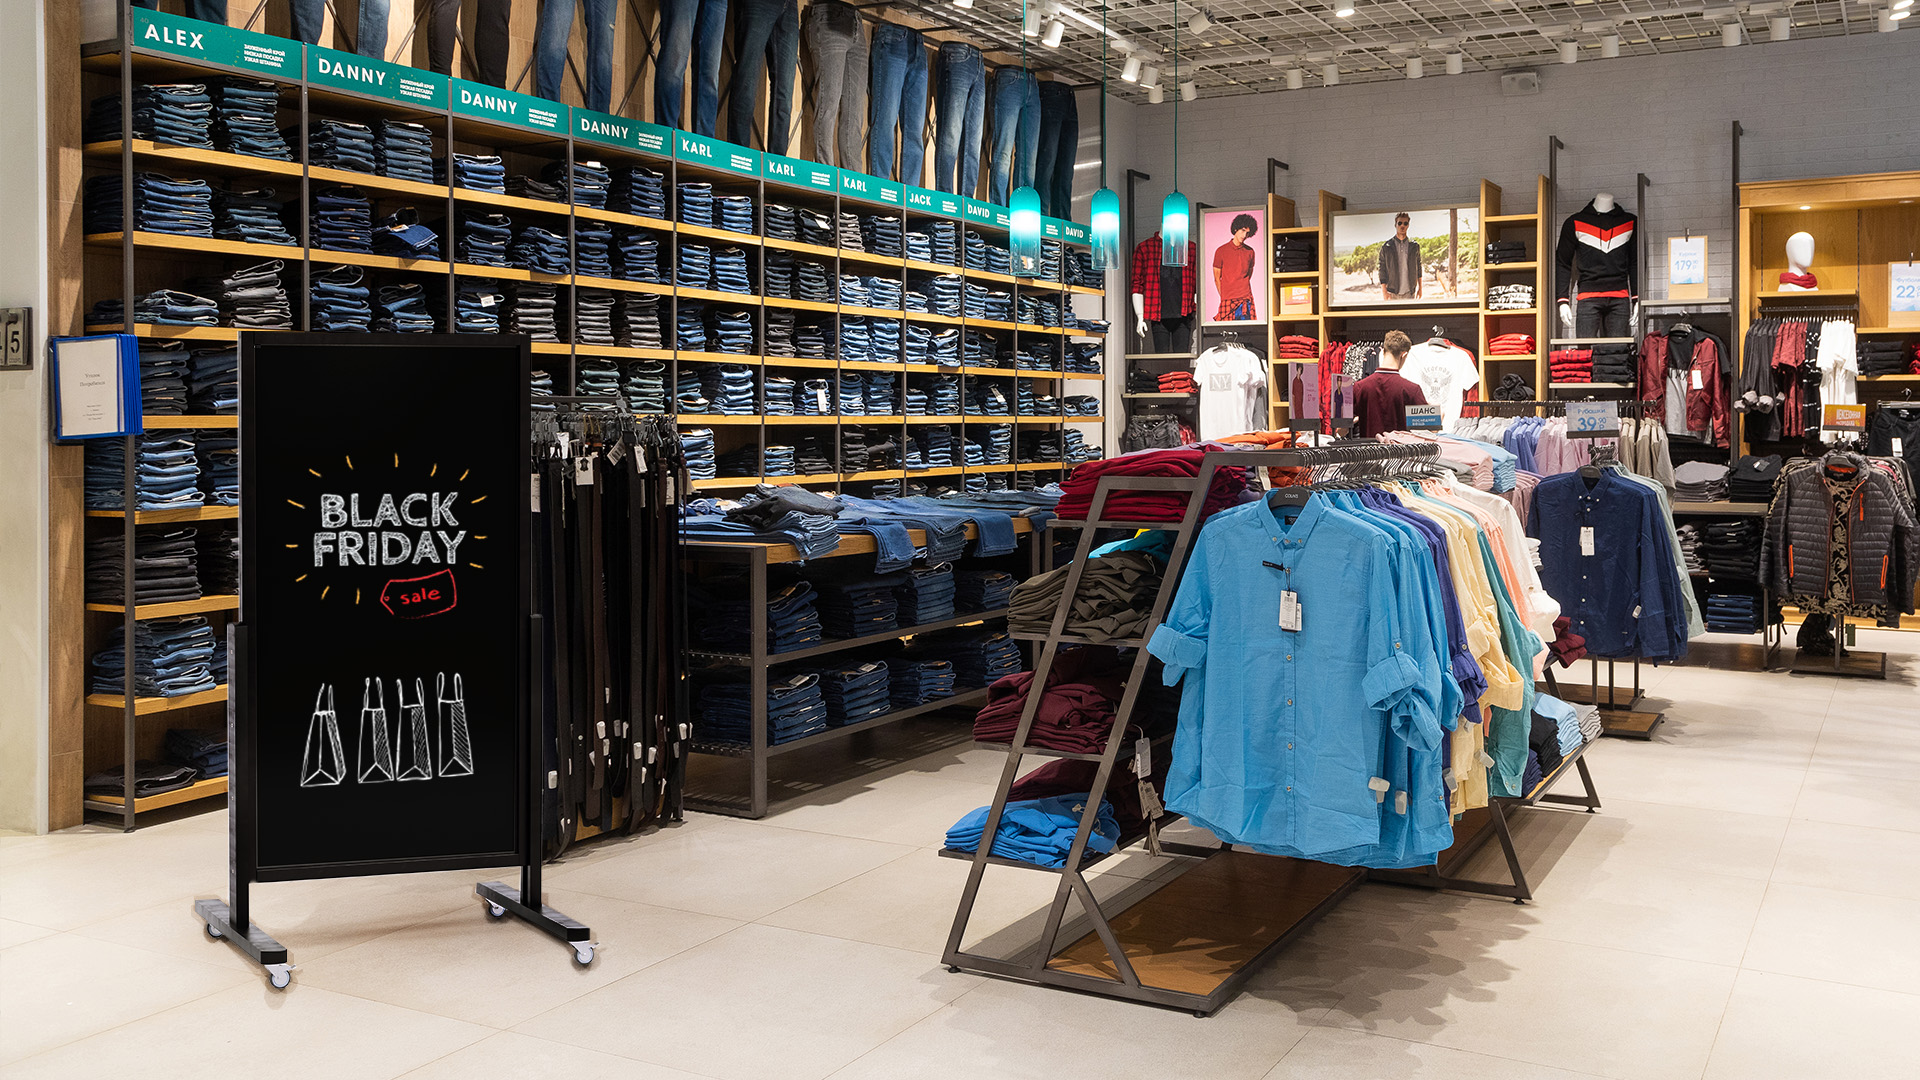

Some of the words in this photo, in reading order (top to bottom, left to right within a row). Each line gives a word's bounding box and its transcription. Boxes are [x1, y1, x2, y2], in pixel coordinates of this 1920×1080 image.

[144, 23, 204, 50] ALEX
[318, 58, 386, 86] DANNY
[461, 89, 517, 115] DANNY
[581, 118, 629, 140] DANNY
[682, 138, 713, 158] KARL
[769, 161, 796, 177] KARL
[844, 176, 867, 192] KARL
[909, 193, 931, 206] JACK
[967, 203, 990, 218] DAVID
[1065, 226, 1084, 239] DAVID
[1674, 259, 1692, 270] 179
[1896, 285, 1915, 298] 22
[1210, 374, 1231, 390] NY
[1411, 407, 1435, 415] ШАНС
[1577, 416, 1597, 431] 39
[320, 491, 459, 528] BLACK
[313, 530, 467, 567] FRIDAY
[400, 587, 442, 605] sale
